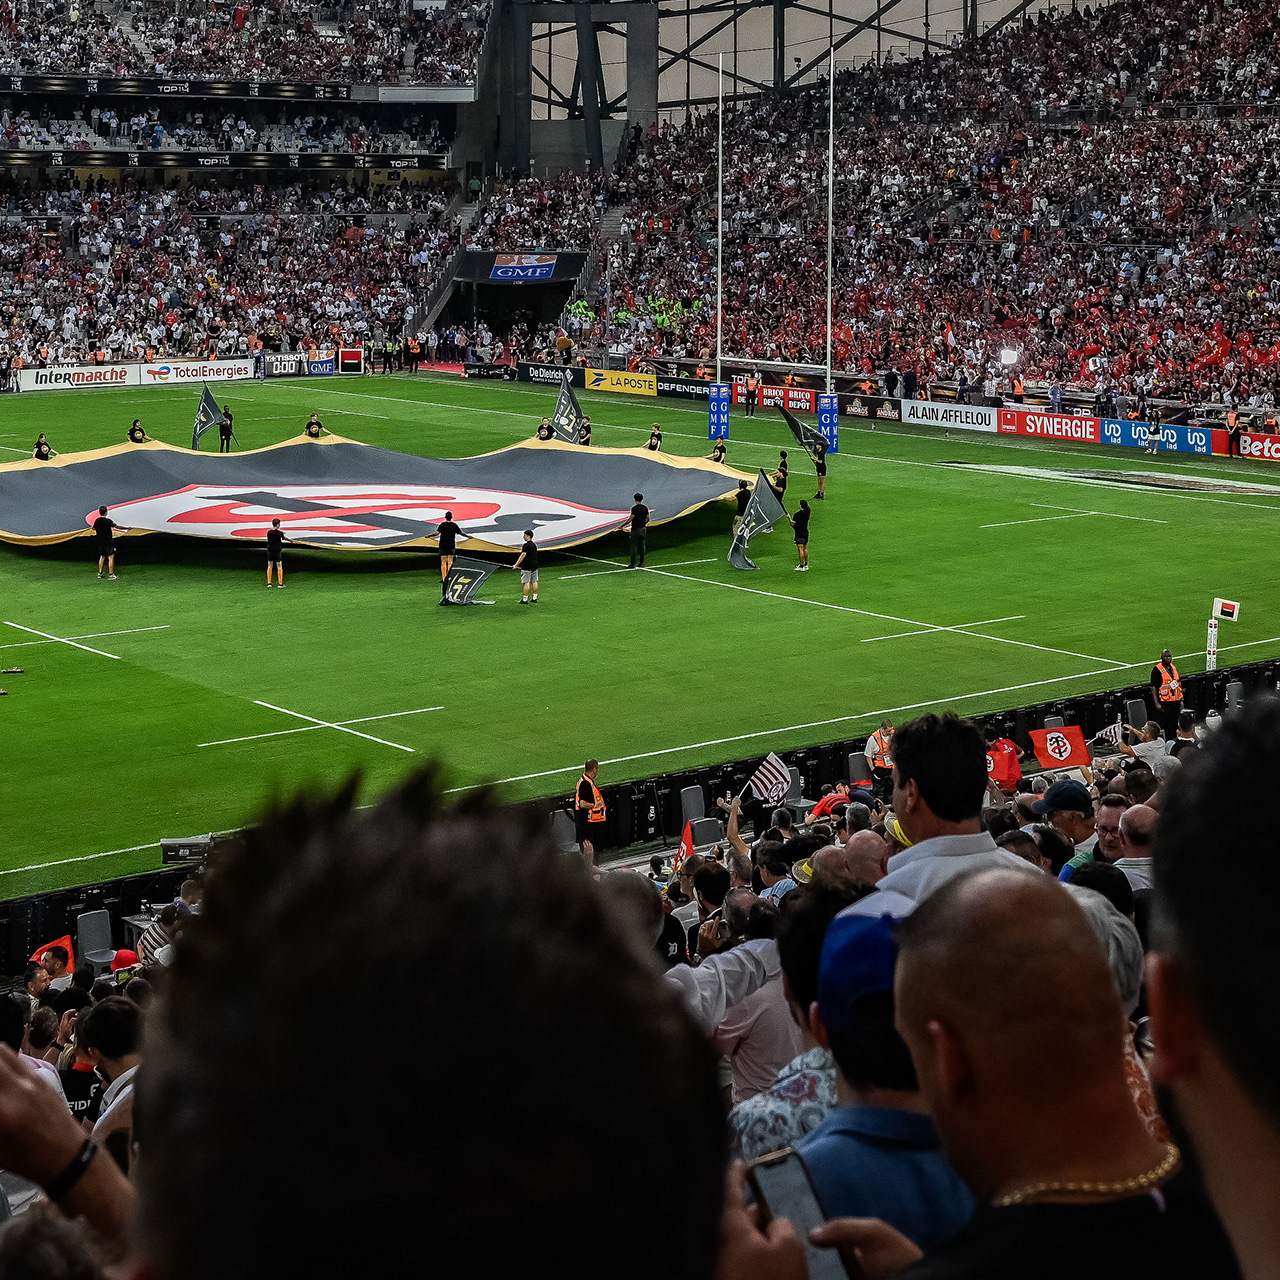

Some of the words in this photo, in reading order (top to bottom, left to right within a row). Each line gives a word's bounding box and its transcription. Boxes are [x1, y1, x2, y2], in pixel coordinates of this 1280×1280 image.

[496, 268, 549, 277] GMF
[173, 364, 248, 378] TotalEnergies
[310, 363, 333, 372] GMF
[529, 367, 539, 377] De
[539, 368, 564, 380] Dietrich
[610, 376, 623, 387] LA
[624, 377, 654, 390] POSTE
[658, 382, 710, 394] DEFENDER
[763, 387, 784, 397] BRICO
[789, 390, 810, 400] BRICO
[789, 399, 810, 410] DEPÔT
[846, 406, 869, 415] ANDROS
[876, 409, 899, 418] ANDROS
[908, 405, 938, 420] ALAIN
[941, 409, 991, 426] AFFLELOU
[1025, 415, 1094, 438] SYNERGIE
